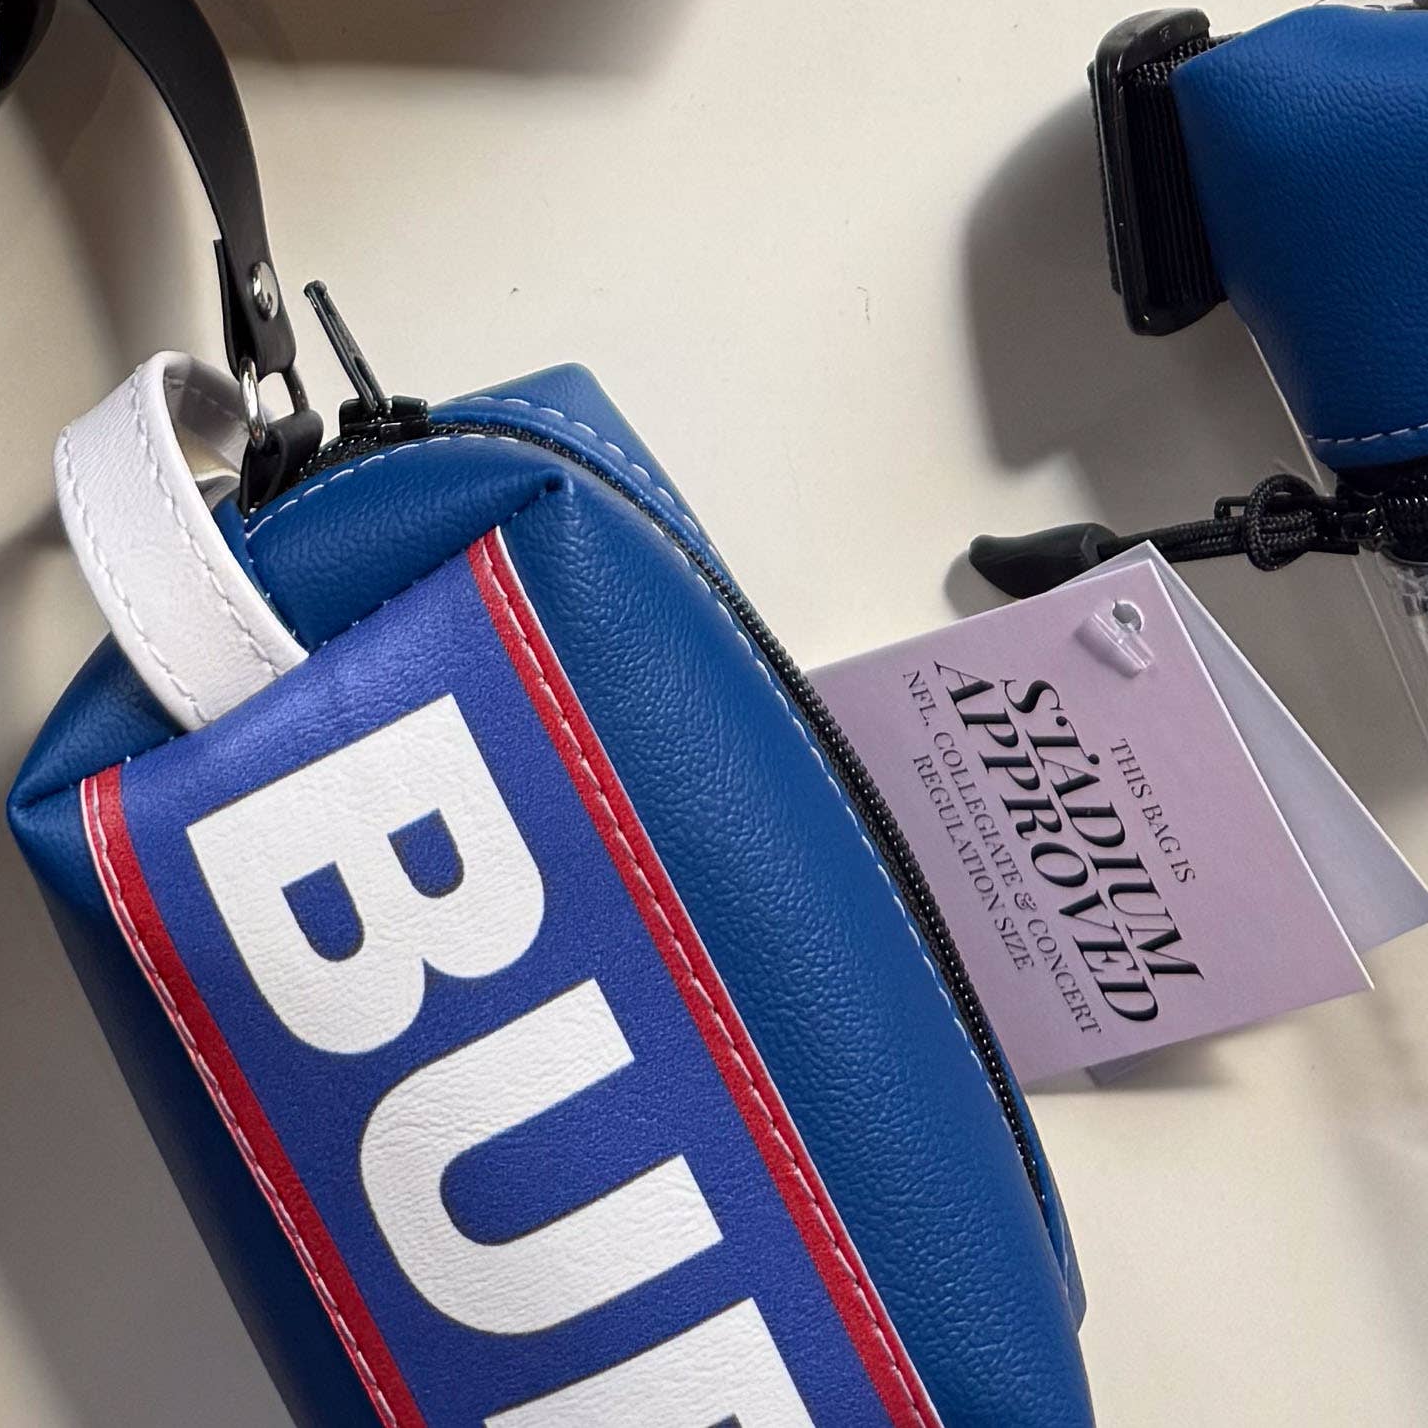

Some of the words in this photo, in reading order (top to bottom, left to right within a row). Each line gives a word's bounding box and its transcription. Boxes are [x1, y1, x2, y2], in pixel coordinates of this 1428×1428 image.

[902, 670, 938, 727] NFL,
[933, 732, 1024, 887] COLLEGIATE
[1013, 892, 1037, 911] &
[1027, 918, 1102, 1034] CONCERT
[912, 754, 1000, 912] REGULATION
[994, 916, 1035, 971] SIZE
[933, 660, 1159, 1023] APPROVED
[999, 679, 1205, 981] STADIUM
[1110, 738, 1153, 799] THIS
[1141, 804, 1181, 854] BAG
[1170, 859, 1193, 884] IS
